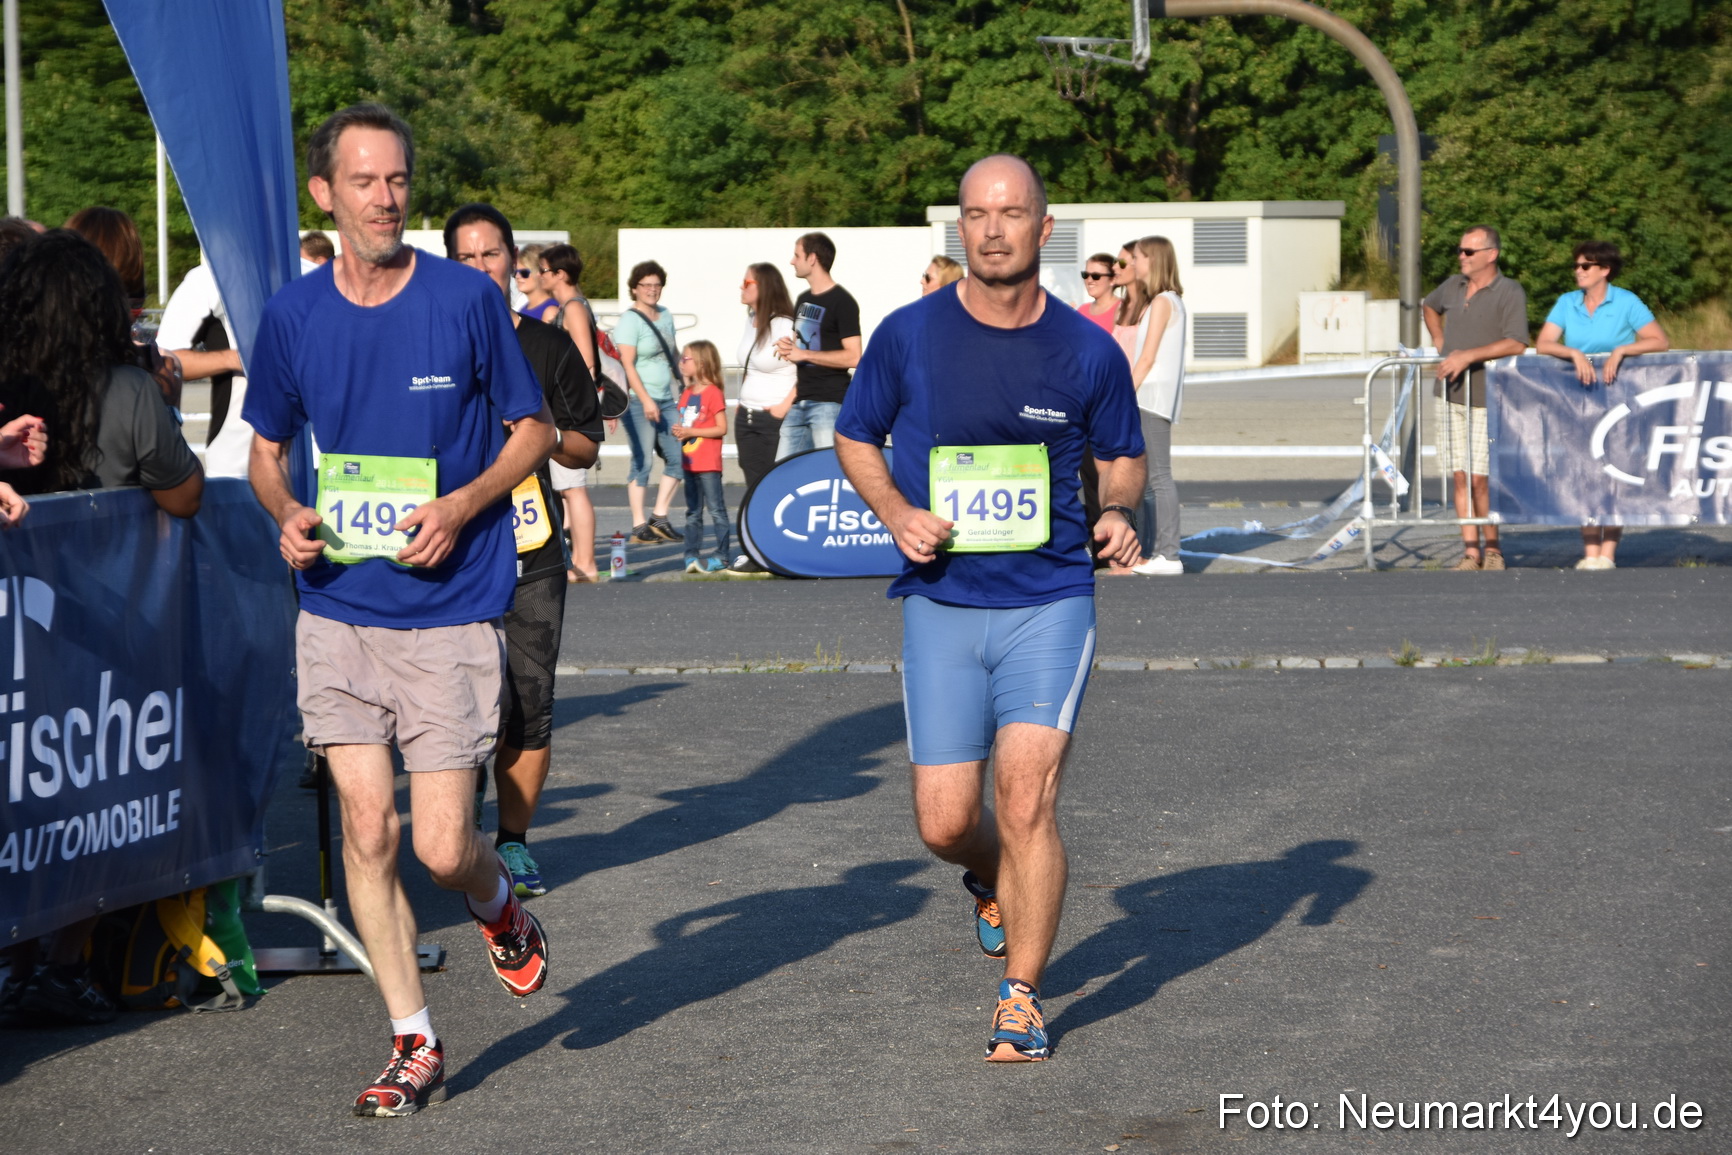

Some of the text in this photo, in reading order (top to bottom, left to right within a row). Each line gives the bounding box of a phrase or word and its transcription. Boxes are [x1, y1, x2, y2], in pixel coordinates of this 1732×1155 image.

[1024, 405, 1066, 418] Sport-Team
[944, 488, 1038, 521] 1495
[807, 504, 889, 533] Fisc
[992, 529, 1014, 538] Unger
[345, 542, 372, 550] Thomas
[0, 788, 181, 874] AUTOMOBILE
